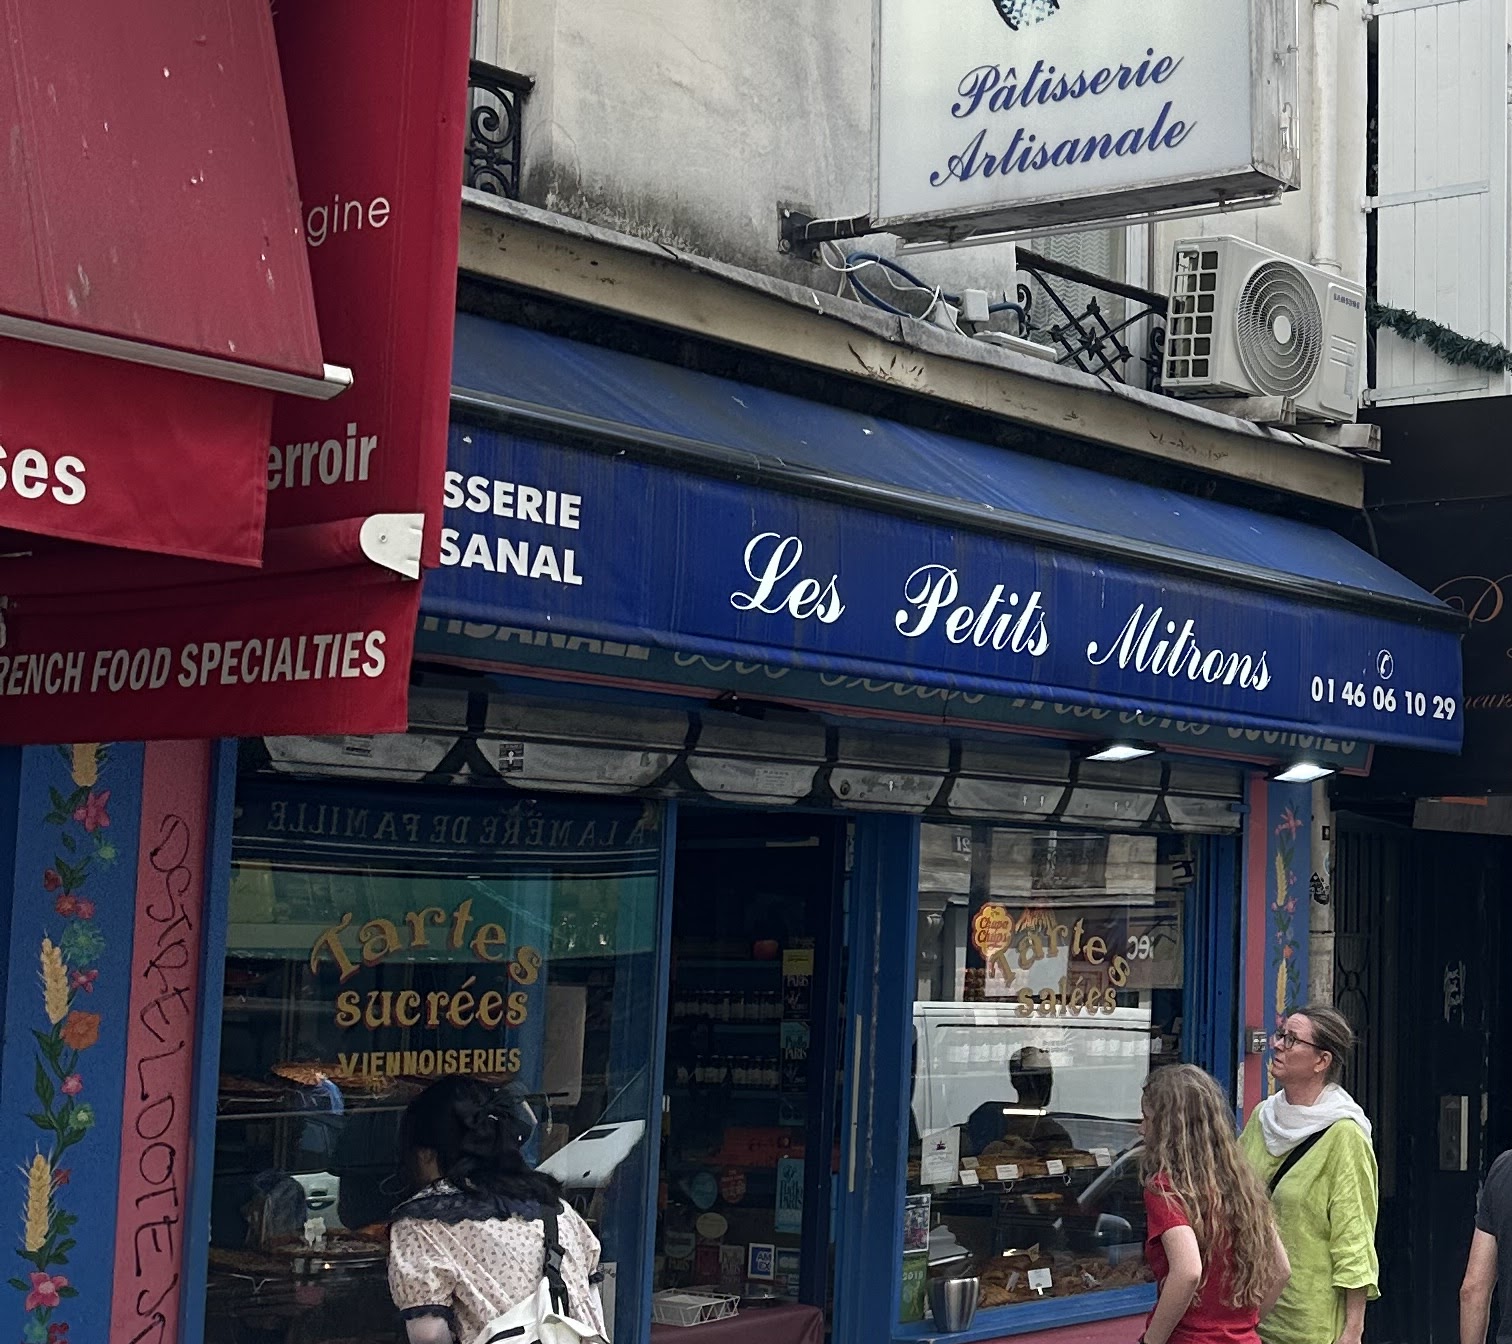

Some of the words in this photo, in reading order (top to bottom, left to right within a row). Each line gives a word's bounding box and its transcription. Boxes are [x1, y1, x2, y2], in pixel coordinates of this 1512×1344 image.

[951, 49, 1185, 119] Pâtisserie
[930, 101, 1197, 187] Artisanale
[300, 195, 391, 247] gine
[0, 446, 87, 505] es
[730, 531, 846, 625] Les
[895, 563, 1050, 660] Petits
[1087, 602, 1272, 692] Mitrons
[90, 647, 171, 692] FOOD
[178, 630, 387, 687] SPECIALTIES
[1310, 675, 1337, 702] 01
[1341, 679, 1367, 708] 46
[1373, 684, 1398, 713] 06
[1404, 690, 1427, 718] 10
[1432, 693, 1457, 722] 29
[309, 897, 543, 987] Tartes
[977, 929, 1008, 945] Chups
[979, 915, 1009, 930] Chupa
[989, 918, 1131, 988] Tartes
[334, 978, 529, 1031] sucrées
[1016, 977, 1117, 1018] salées
[337, 1047, 522, 1080] VIENNOISERIES
